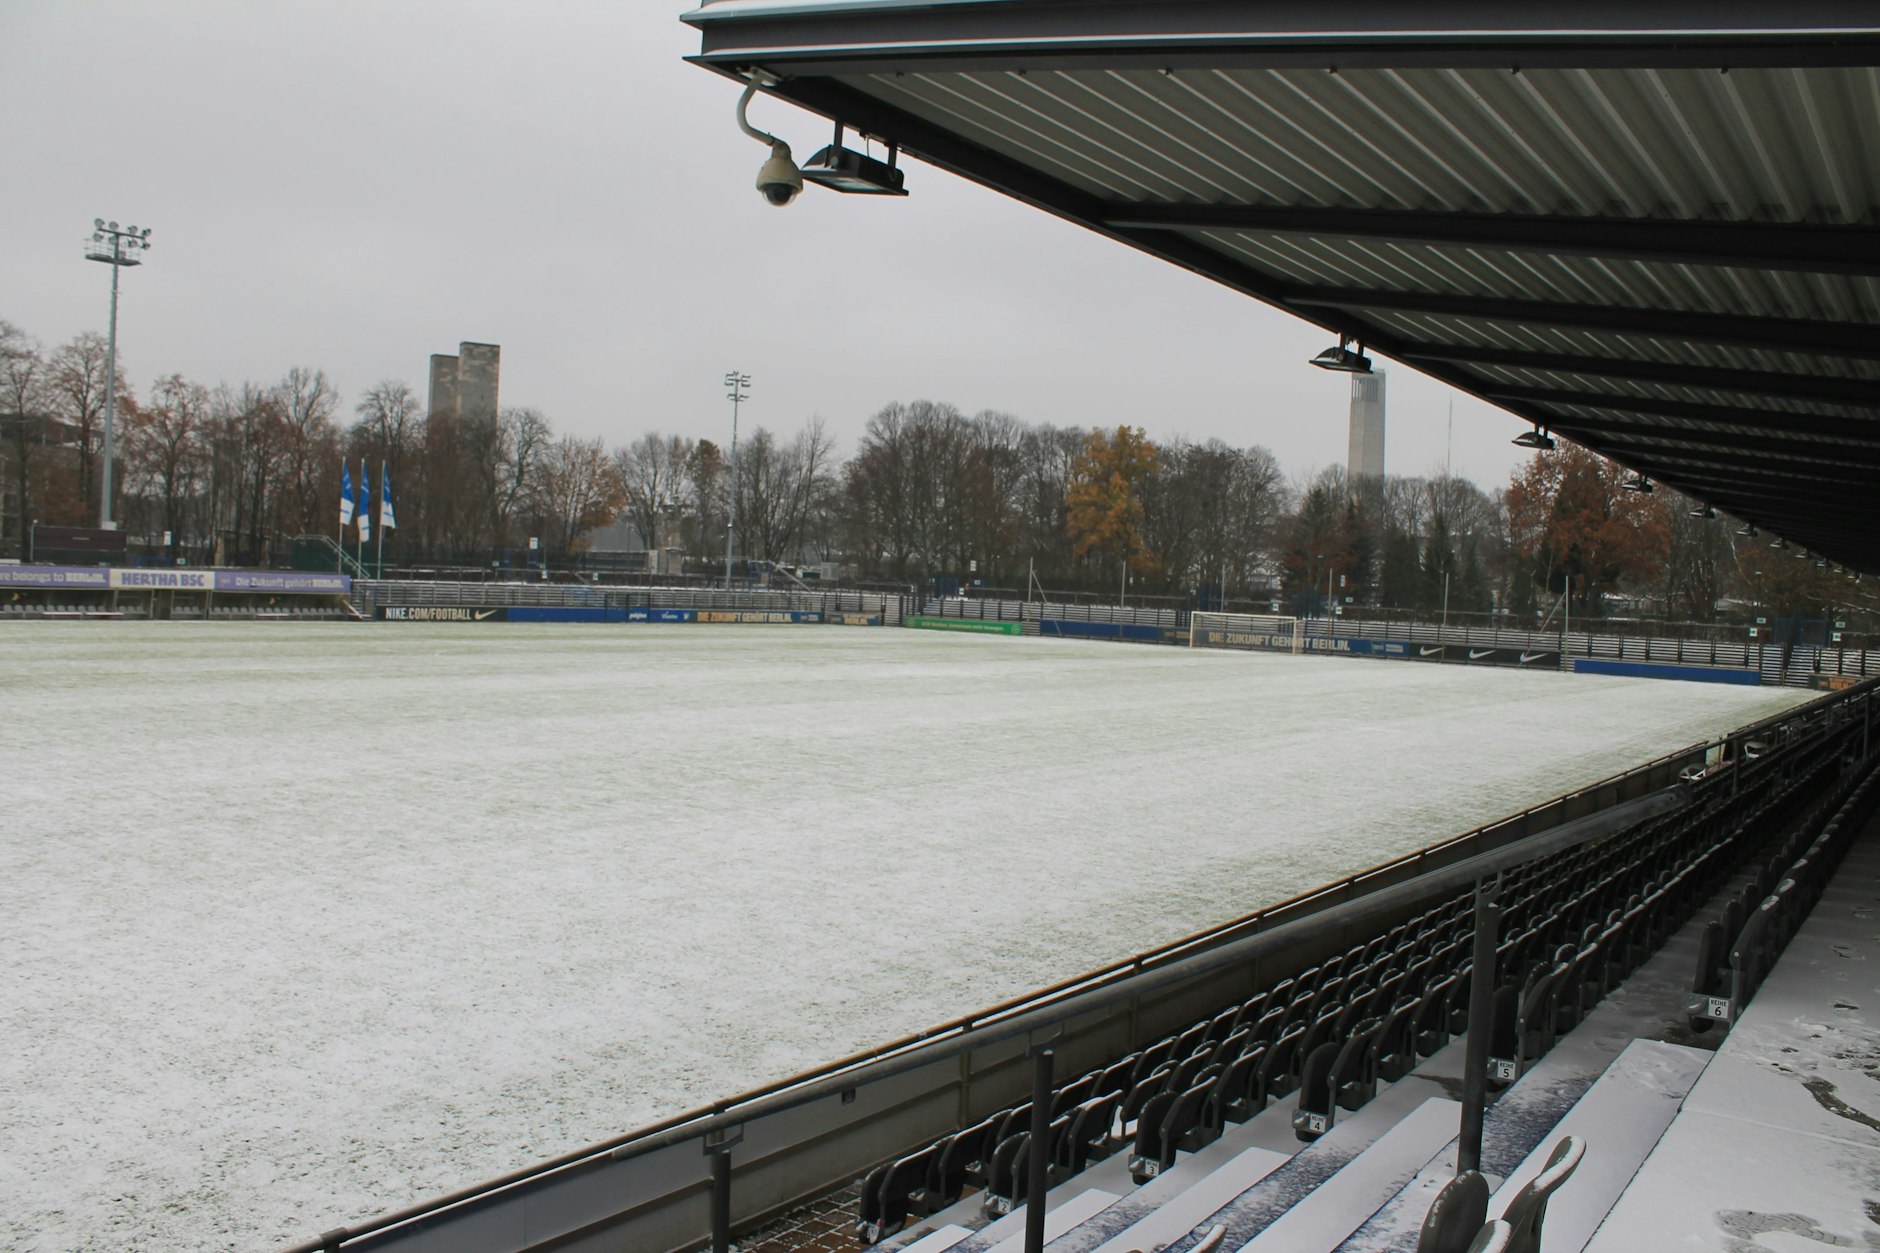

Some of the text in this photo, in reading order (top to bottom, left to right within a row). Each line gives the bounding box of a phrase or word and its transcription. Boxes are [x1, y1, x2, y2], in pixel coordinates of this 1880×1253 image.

[121, 572, 205, 586] HERTHA BSC
[385, 607, 471, 620] NIKE.COM/FOOTBALL
[1226, 632, 1271, 646] ZUKUNFT
[1711, 999, 1728, 1007] REIHE
[1714, 1006, 1722, 1016] 6
[1503, 1068, 1510, 1078] 5
[1314, 1121, 1321, 1131] 4
[1149, 1166, 1155, 1175] 3
[1002, 1203, 1007, 1212] 2
